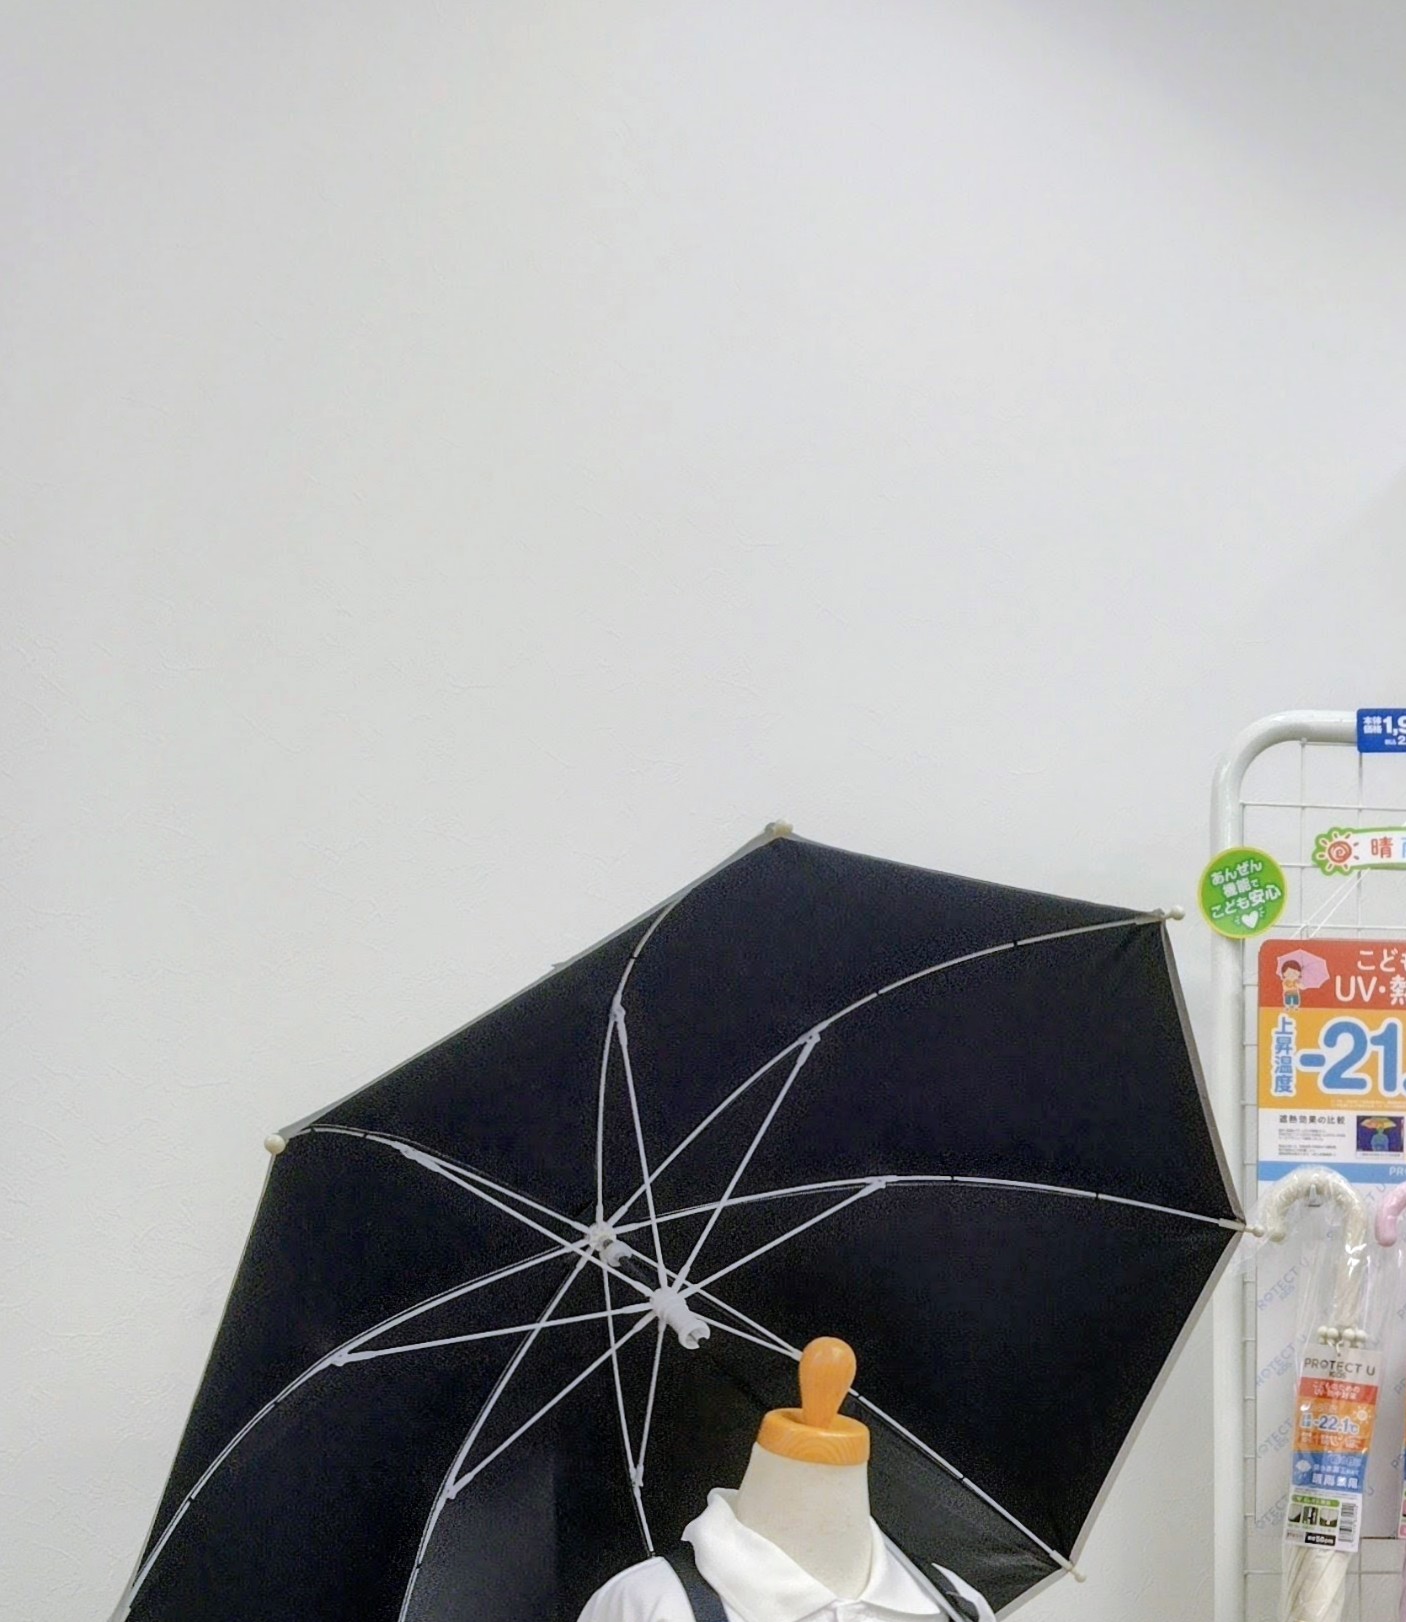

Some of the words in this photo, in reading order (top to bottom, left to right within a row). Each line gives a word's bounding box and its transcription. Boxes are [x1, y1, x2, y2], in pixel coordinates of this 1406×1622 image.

[1211, 860, 1263, 887] あんぜん
[1223, 878, 1260, 898] 機能で
[1211, 885, 1281, 919] こども安心
[1273, 1016, 1294, 1093] 上昇温度
[1279, 1115, 1345, 1124] 遮熱効果の比較
[1304, 1358, 1362, 1373] PROTECT
[1366, 1366, 1376, 1376] U
